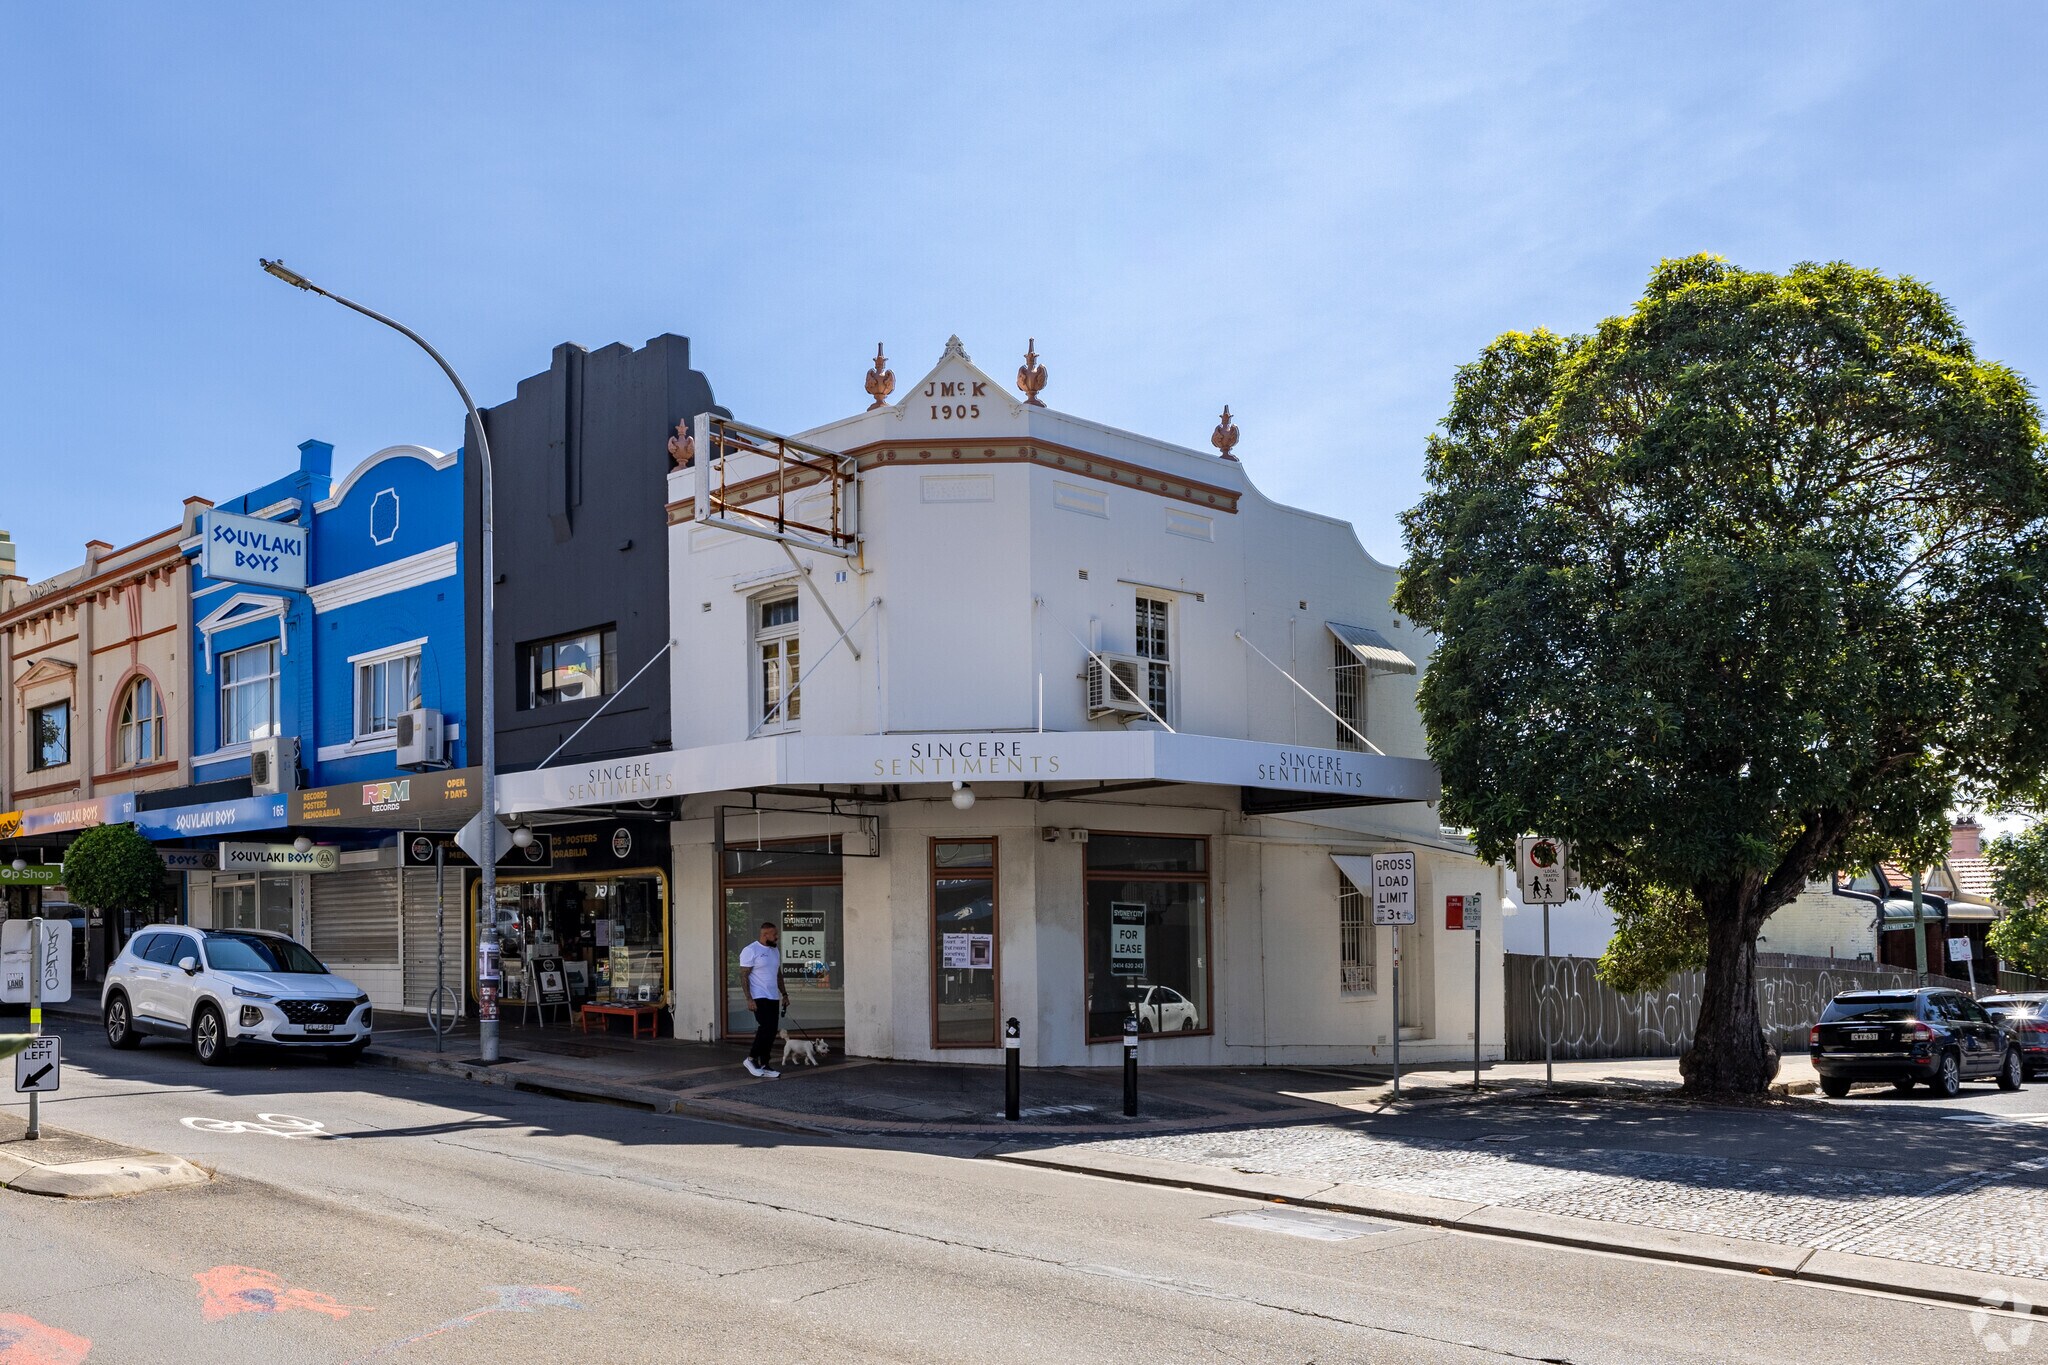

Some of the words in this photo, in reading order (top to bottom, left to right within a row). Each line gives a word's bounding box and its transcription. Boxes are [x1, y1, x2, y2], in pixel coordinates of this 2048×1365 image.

[930, 404, 980, 420] 1905
[213, 524, 301, 556] SOUVLAKI
[235, 550, 279, 573] BOYS
[910, 741, 1021, 758] SINCERE
[873, 755, 1060, 777] SENTIMENTS
[1280, 751, 1342, 771] SINCERE
[588, 762, 651, 783] SINCERE
[1258, 763, 1362, 788] SENTIMENTS
[446, 778, 465, 788] OPEN
[568, 773, 673, 801] SENTIMENTS
[303, 790, 328, 801] RECORDS
[362, 779, 411, 806] RPM
[444, 790, 449, 800] 7
[450, 788, 468, 799] DAYS
[122, 802, 132, 813] 167
[272, 804, 284, 817] 165
[303, 800, 327, 810] POSTERS
[371, 802, 400, 813] RECORDS
[53, 808, 82, 826] SOUVLAKI
[82, 805, 98, 821] BOYS
[176, 811, 213, 830] SOUVLAKI
[215, 807, 236, 825] BOYS
[303, 808, 342, 820] MEMORABILIA
[565, 833, 598, 844] POSTERS
[168, 854, 198, 865] BOYS
[230, 850, 284, 863] SOUVLAKI
[287, 852, 314, 863] BOYS
[1375, 858, 1412, 871] GROSS
[25, 868, 54, 880] Shop
[1378, 876, 1409, 887] LOAD
[1379, 892, 1408, 904] LIMIT
[791, 936, 815, 945] FOR
[1119, 930, 1138, 939] FOR
[785, 949, 821, 959] LEASE
[1114, 943, 1142, 953] LEASE
[24, 1051, 52, 1060] LEFT
